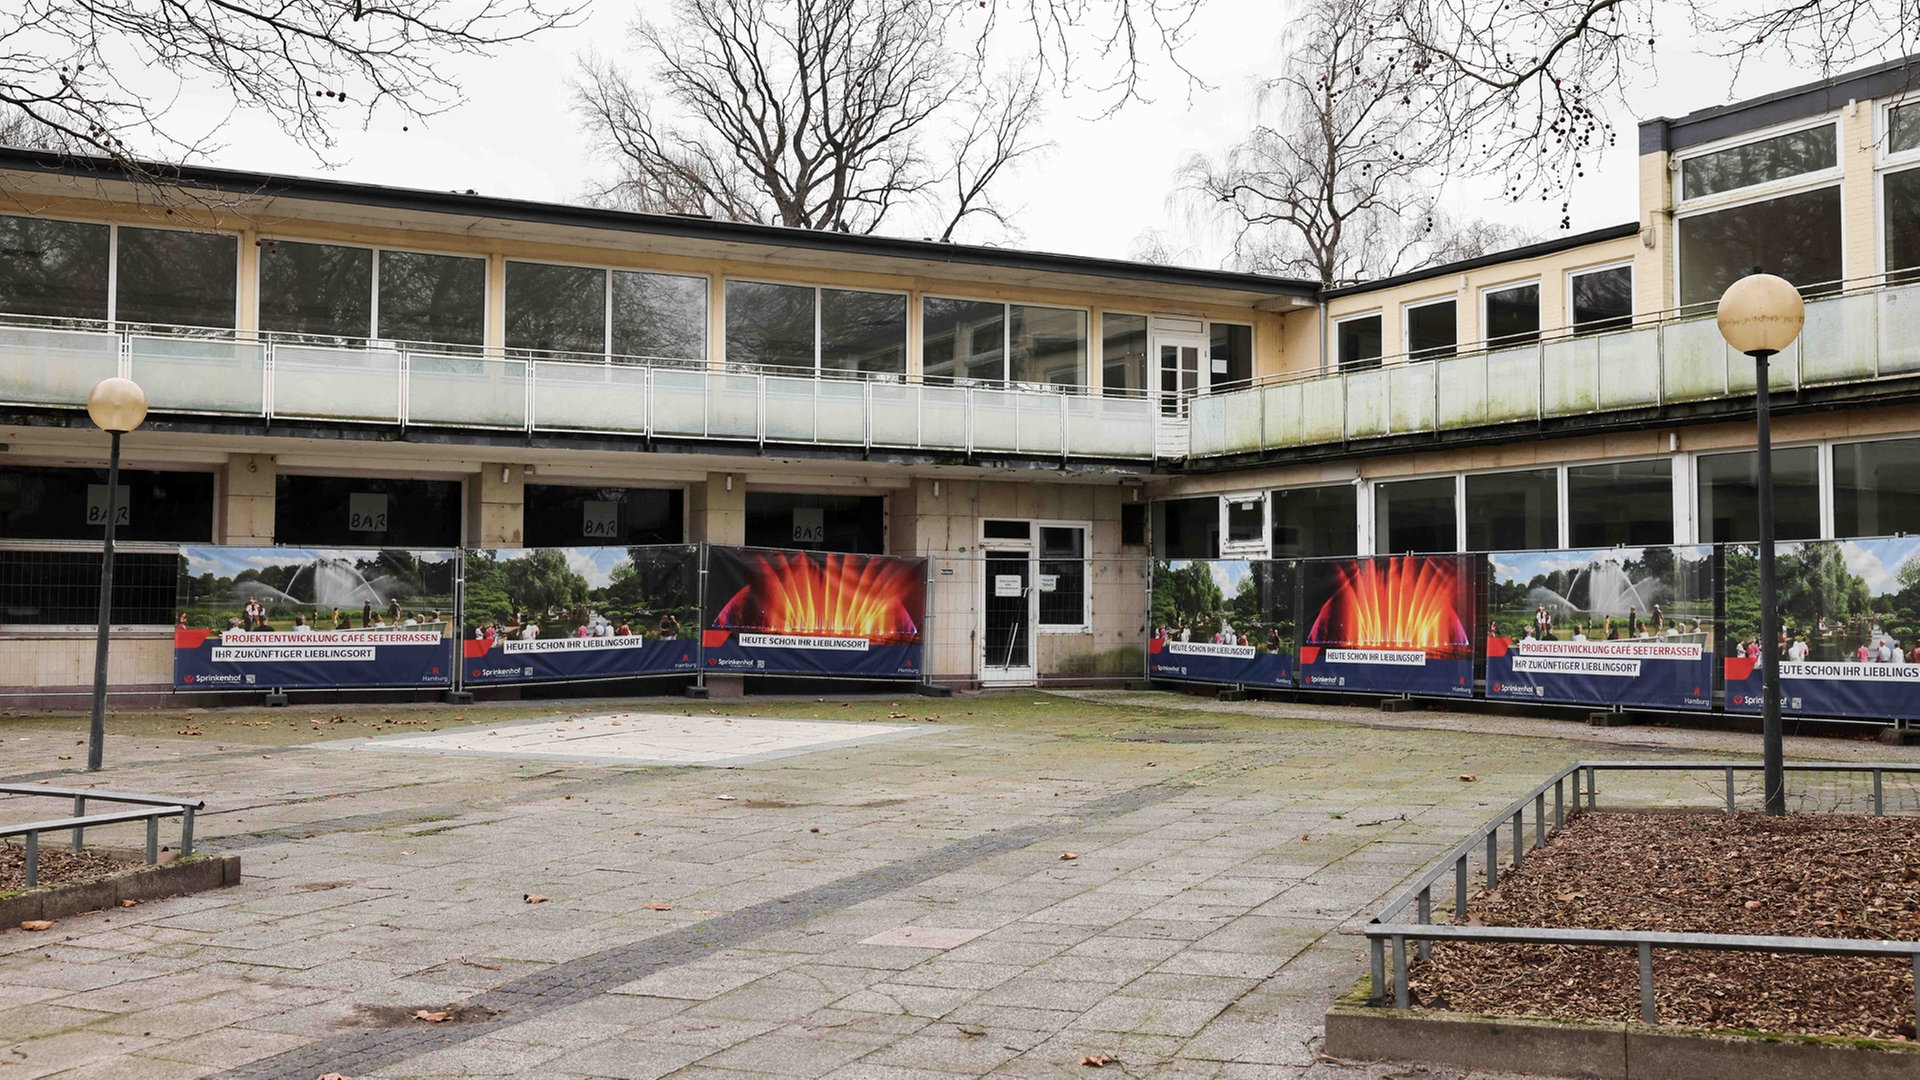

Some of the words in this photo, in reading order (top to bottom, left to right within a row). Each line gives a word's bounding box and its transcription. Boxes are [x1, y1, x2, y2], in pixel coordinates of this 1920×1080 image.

[351, 513, 385, 530] BAR
[585, 520, 616, 535] BAR
[794, 526, 822, 540] BAR
[225, 634, 339, 643] PROJEKTENTWICKLUNG
[340, 632, 365, 643] CAFÉ
[367, 633, 438, 642] SEETERRASSEN
[741, 636, 767, 645] HEUTE
[769, 637, 797, 646] SCHON
[798, 638, 812, 646] IHR
[813, 639, 867, 648] LIEBLINGSORT
[506, 642, 534, 651] HEUTE
[535, 641, 565, 650] SCHON
[566, 640, 582, 649] IHR
[583, 637, 641, 648] LIEBLINGSORT
[215, 650, 232, 658] IHR
[234, 648, 302, 659] ZUKÜNFTIGER
[304, 649, 373, 658] LIEBLINGSORT
[1170, 644, 1188, 652] HEUTE
[1188, 645, 1207, 653] SCHON
[1217, 647, 1255, 656] LIEBLINGSORT
[1521, 643, 1610, 655] PROJEKTENTWICKLUNG
[1611, 645, 1631, 655] CAFÉ
[1633, 646, 1699, 657] SEETERRASSEN
[718, 658, 754, 667] Sprinkenhof
[1327, 652, 1346, 660] HEUTE
[1347, 653, 1368, 661] SCHON
[1380, 654, 1424, 663] LIEBLINGSORT
[1514, 660, 1527, 669] IHR
[1528, 659, 1580, 670] ZUKÜNFTIGER
[1581, 662, 1638, 672] LIEBLINGSORT
[482, 667, 521, 677] Sprinkenhof
[1778, 665, 1802, 675] EUTE
[1804, 665, 1841, 676] SCHON
[1843, 666, 1861, 677] IHR
[1863, 667, 1919, 678] LIEBLINGS
[195, 674, 242, 684] Sprinkenhof
[422, 675, 449, 683] Hamburg
[1501, 684, 1534, 693] Sprinkenhof
[1684, 697, 1710, 706] Hamburg
